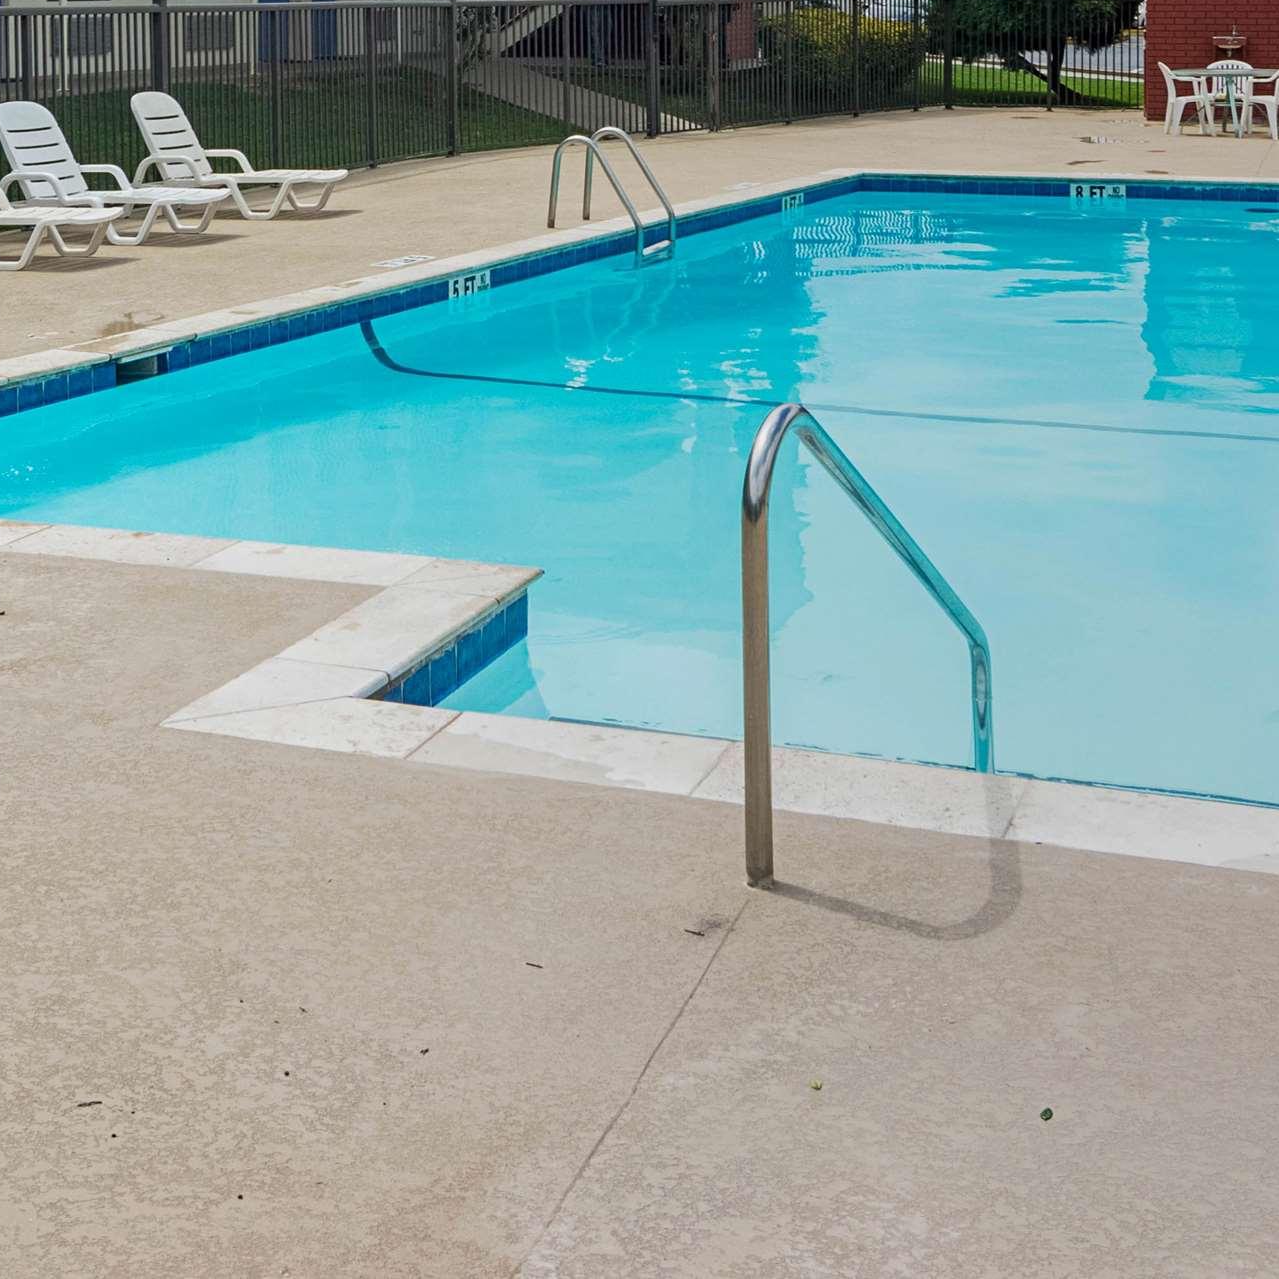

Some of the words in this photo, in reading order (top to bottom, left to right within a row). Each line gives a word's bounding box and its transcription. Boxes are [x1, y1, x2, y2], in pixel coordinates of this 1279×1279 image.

[1075, 185, 1083, 198] 8
[1090, 186, 1105, 198] FT
[464, 276, 476, 296] FT
